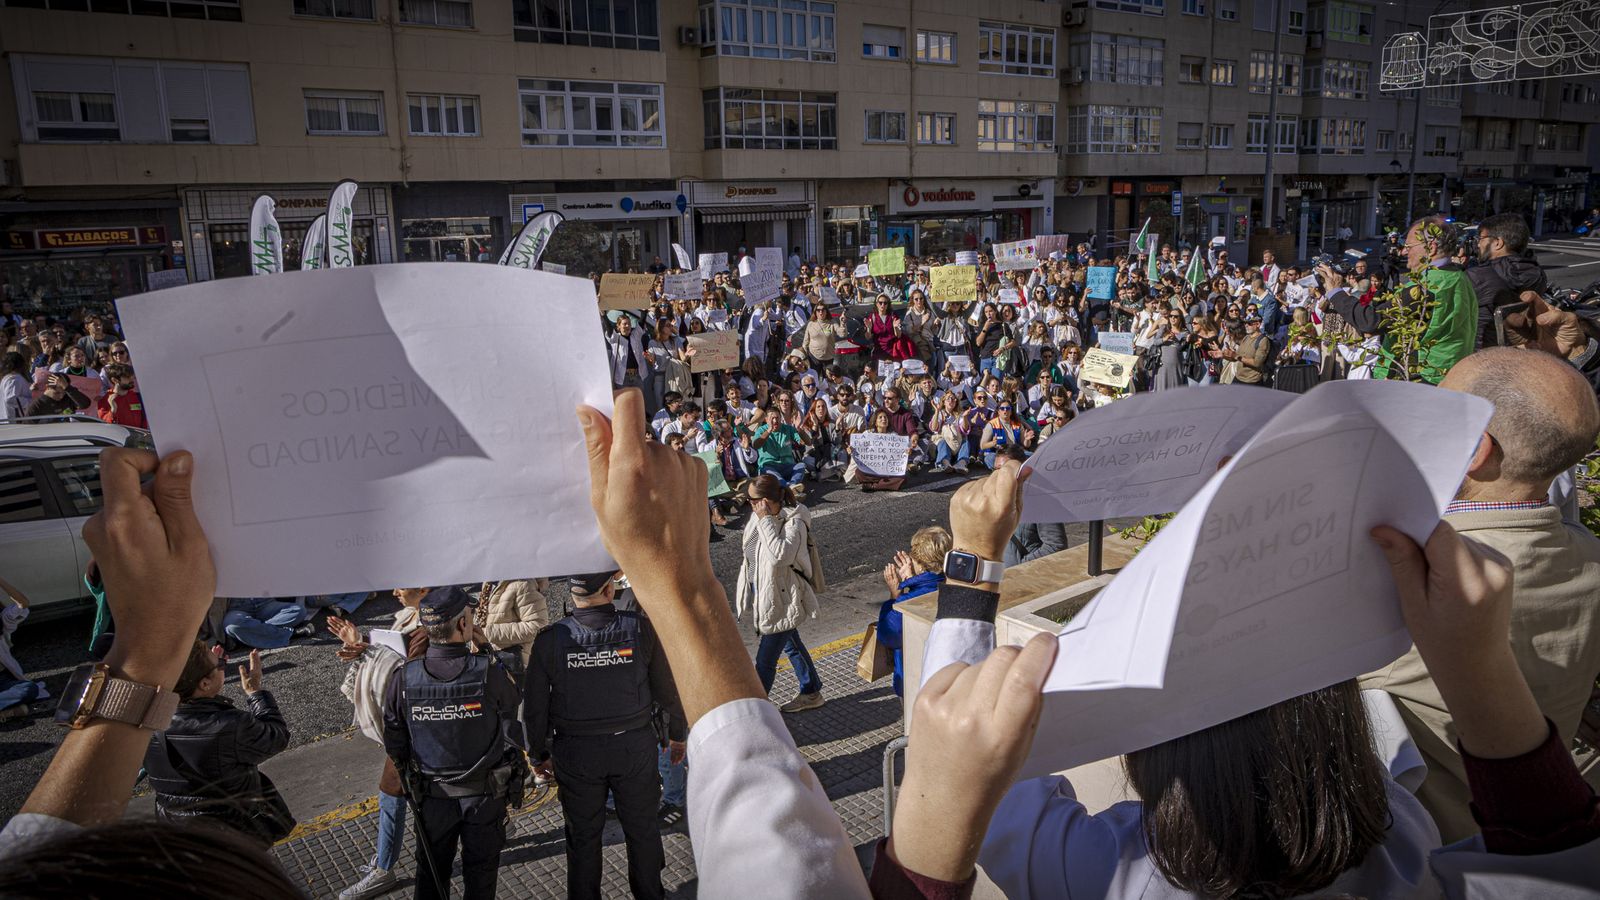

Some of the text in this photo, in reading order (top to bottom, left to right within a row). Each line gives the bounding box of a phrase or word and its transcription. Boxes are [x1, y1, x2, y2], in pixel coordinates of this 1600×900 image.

[738, 187, 777, 195] DONPANES
[1294, 181, 1323, 191] PESTANA
[922, 188, 976, 202] vodafone
[586, 202, 613, 210] Auditivos
[634, 200, 671, 212] Audika
[65, 230, 129, 242] TABACOS
[567, 650, 620, 661] POLICIA
[567, 657, 634, 669] NACIONAL
[411, 704, 468, 713] POLICIA
[411, 711, 483, 722] NACIONAL
